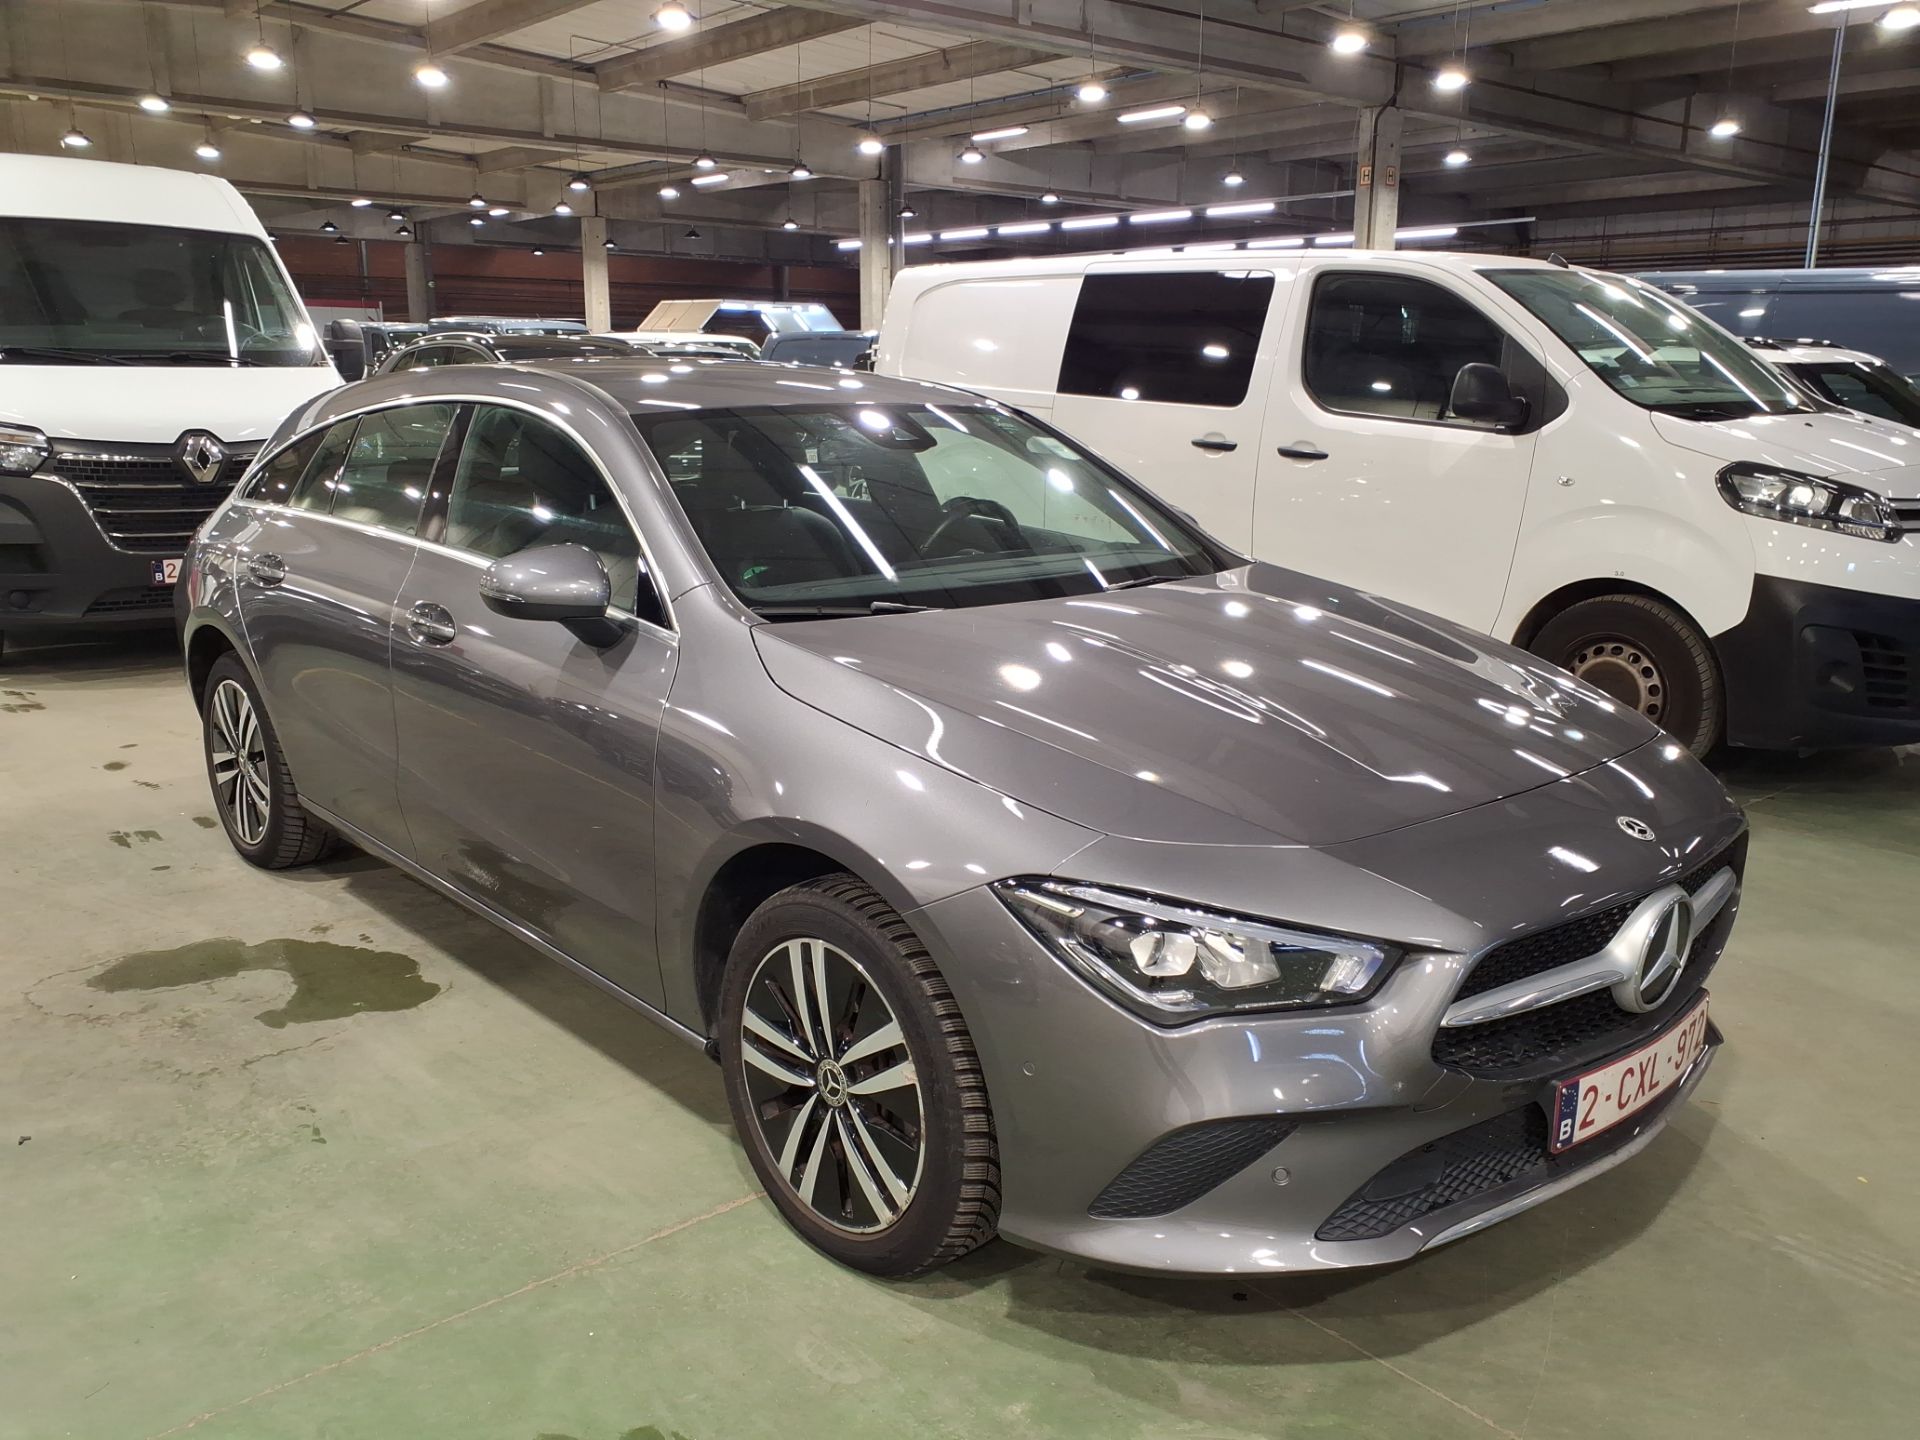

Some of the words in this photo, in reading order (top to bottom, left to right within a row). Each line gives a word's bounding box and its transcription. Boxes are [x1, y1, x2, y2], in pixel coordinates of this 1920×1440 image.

[1363, 169, 1370, 182] H
[1388, 169, 1394, 182] H
[156, 573, 163, 581] B
[1559, 1118, 1572, 1141] B
